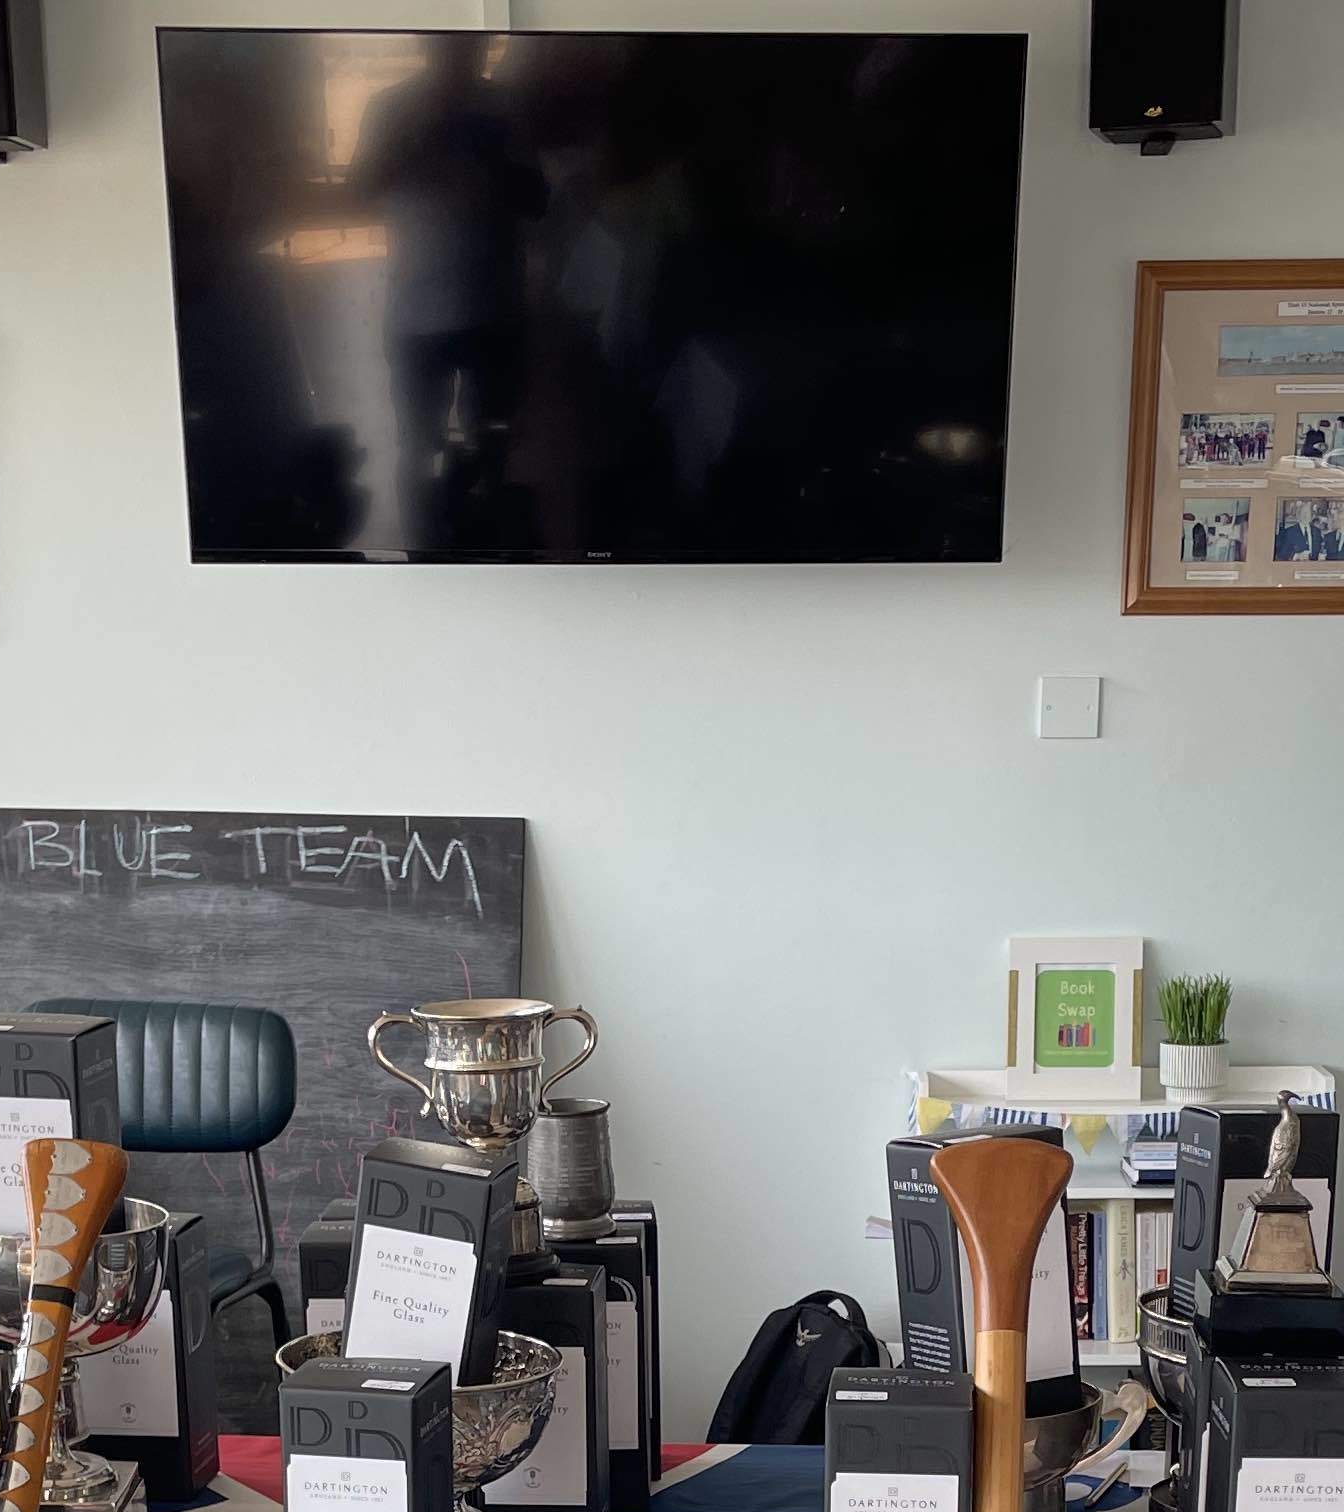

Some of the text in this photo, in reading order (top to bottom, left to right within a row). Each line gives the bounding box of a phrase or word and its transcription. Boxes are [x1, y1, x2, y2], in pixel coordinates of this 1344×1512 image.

[21, 819, 484, 920] BLUE TEAM
[1060, 980, 1095, 995] Book
[1057, 1002, 1096, 1019] Swap
[3, 1176, 24, 1188] Gla
[376, 1250, 458, 1276] DARTINGTON
[371, 1289, 450, 1319] Fine Quality
[392, 1308, 425, 1324] Glass
[118, 1343, 159, 1356] Quality
[112, 1354, 140, 1366] Glass
[304, 1481, 389, 1496] DARTINGTON
[1255, 1484, 1344, 1496] DARTINGTON
[848, 1498, 938, 1510] DARTINGTON
